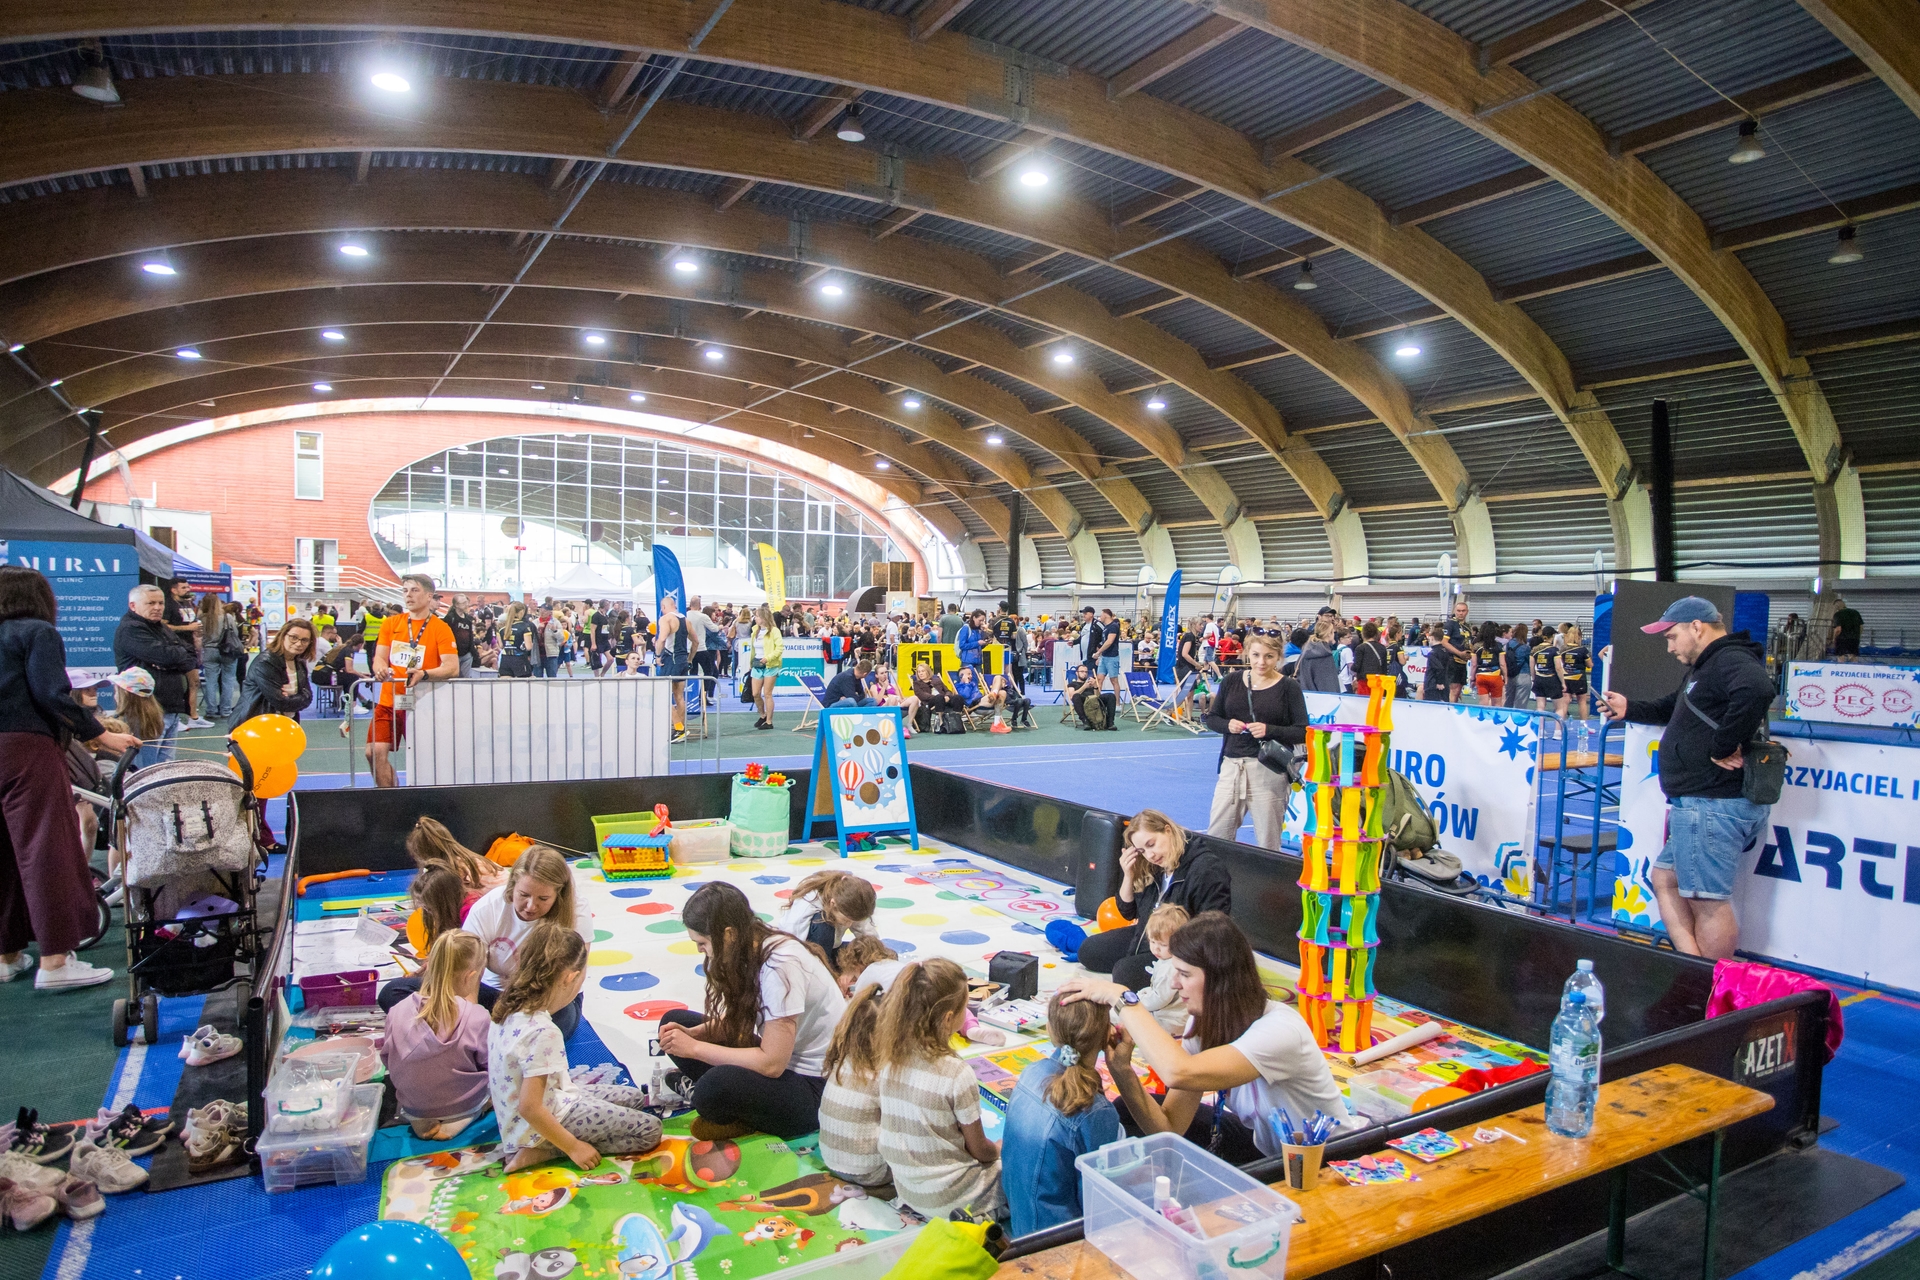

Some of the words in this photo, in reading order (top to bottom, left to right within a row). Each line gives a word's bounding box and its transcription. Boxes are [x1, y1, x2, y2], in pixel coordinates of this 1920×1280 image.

[19, 556, 120, 573] MIRAI
[1830, 670, 1871, 679] PRZYJACIEL
[1873, 672, 1906, 680] IMPREZY
[1799, 692, 1825, 700] PEC
[1834, 694, 1874, 706] PEC
[1883, 697, 1912, 705] PEC
